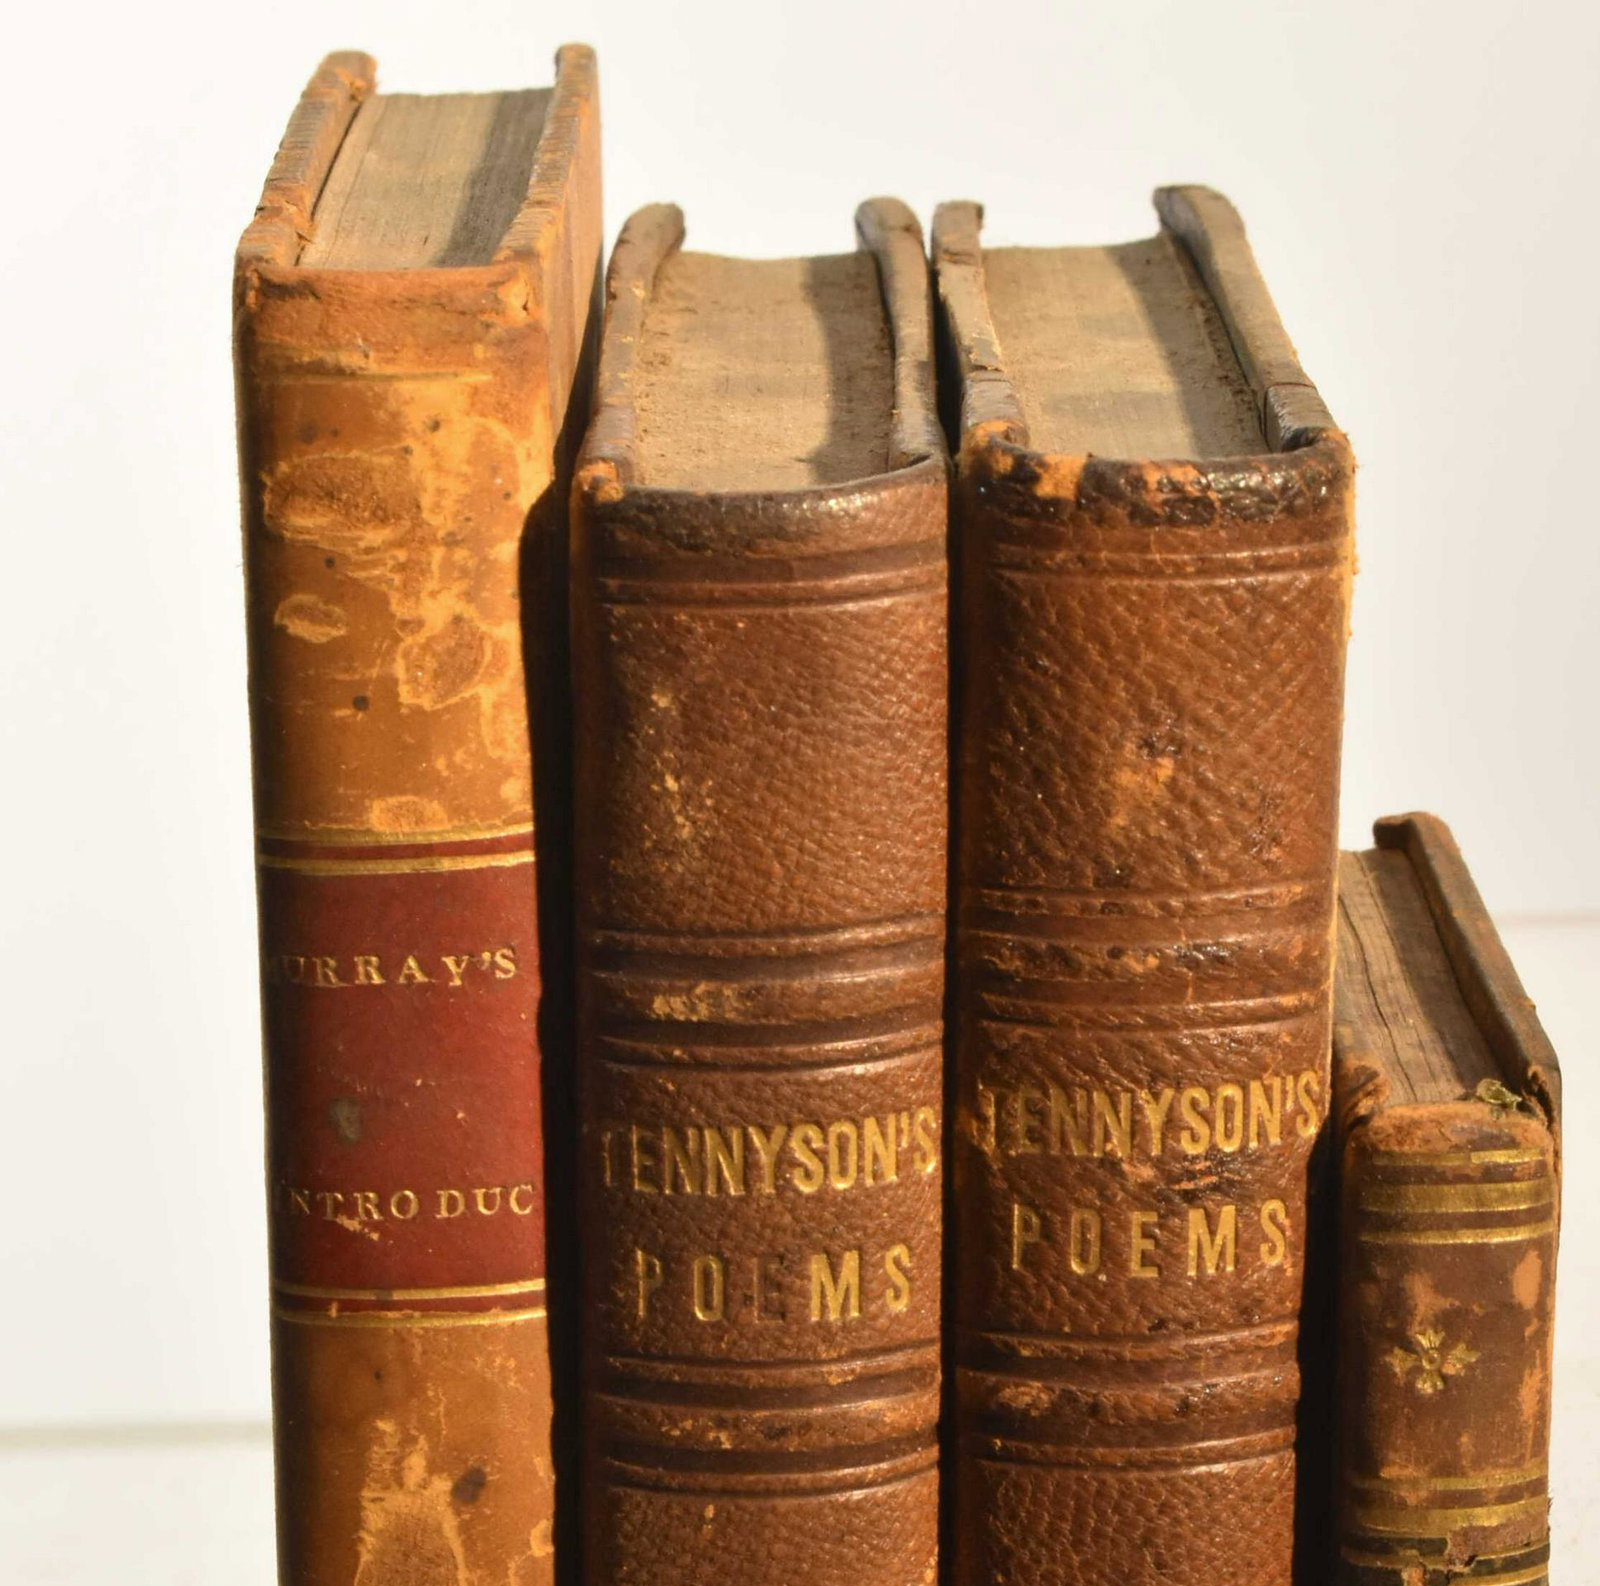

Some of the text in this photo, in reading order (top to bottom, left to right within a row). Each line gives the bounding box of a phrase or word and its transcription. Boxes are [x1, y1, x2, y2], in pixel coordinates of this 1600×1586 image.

[281, 948, 518, 988] URRAY'S
[603, 1106, 938, 1196] TENNYSON'S
[977, 1070, 1320, 1157] TENNYSON'S
[289, 1184, 534, 1221] NTRODUC
[1012, 1199, 1286, 1277] POEMS
[635, 1243, 913, 1323] POEMS
